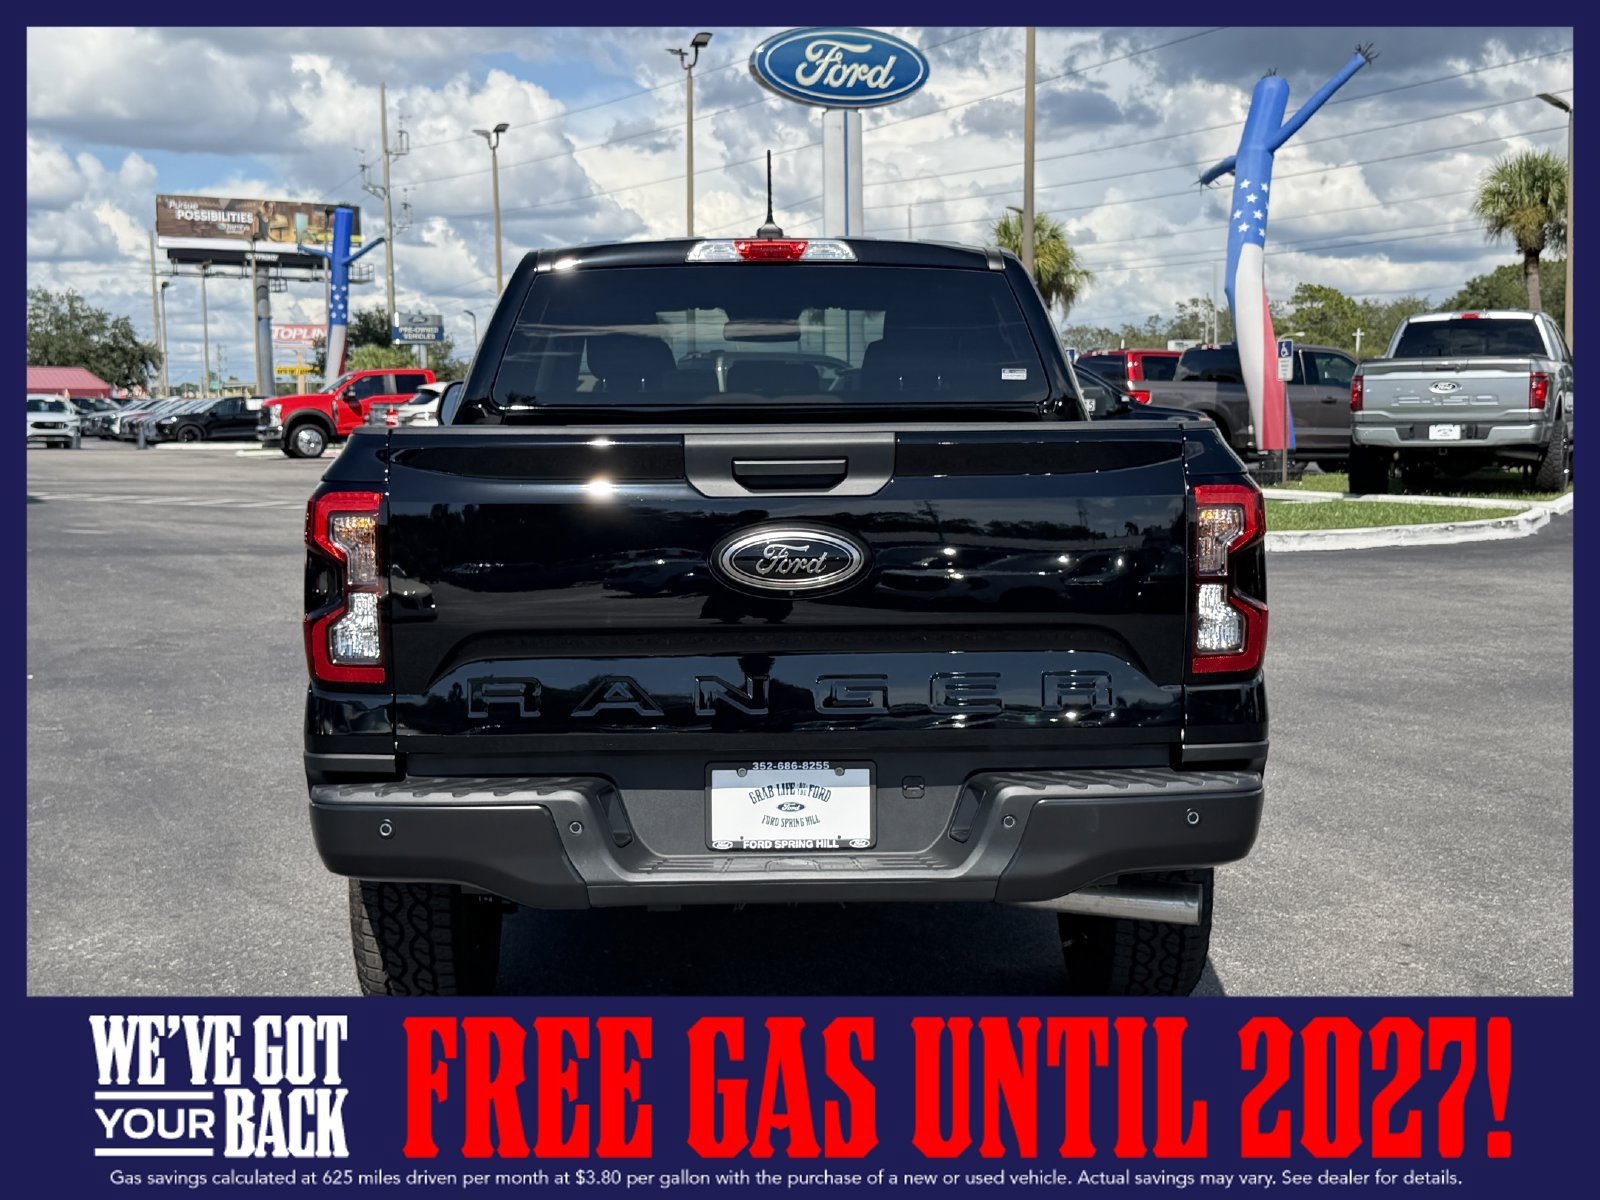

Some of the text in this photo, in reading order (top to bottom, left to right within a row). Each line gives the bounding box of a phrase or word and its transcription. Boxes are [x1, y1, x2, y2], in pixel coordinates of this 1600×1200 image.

[795, 39, 897, 89] Ford
[168, 200, 198, 211] Pursue
[175, 209, 254, 224] POSSIBILITIES
[756, 543, 828, 575] Ford
[467, 670, 1112, 719] RANGER
[752, 761, 830, 771] 352-686-8255
[748, 785, 775, 805] GRAB
[776, 782, 796, 796] LIFE
[808, 784, 832, 803] FORD
[762, 814, 820, 828] FORD SPRING HILL
[743, 839, 840, 849] FORD SPRING HILL
